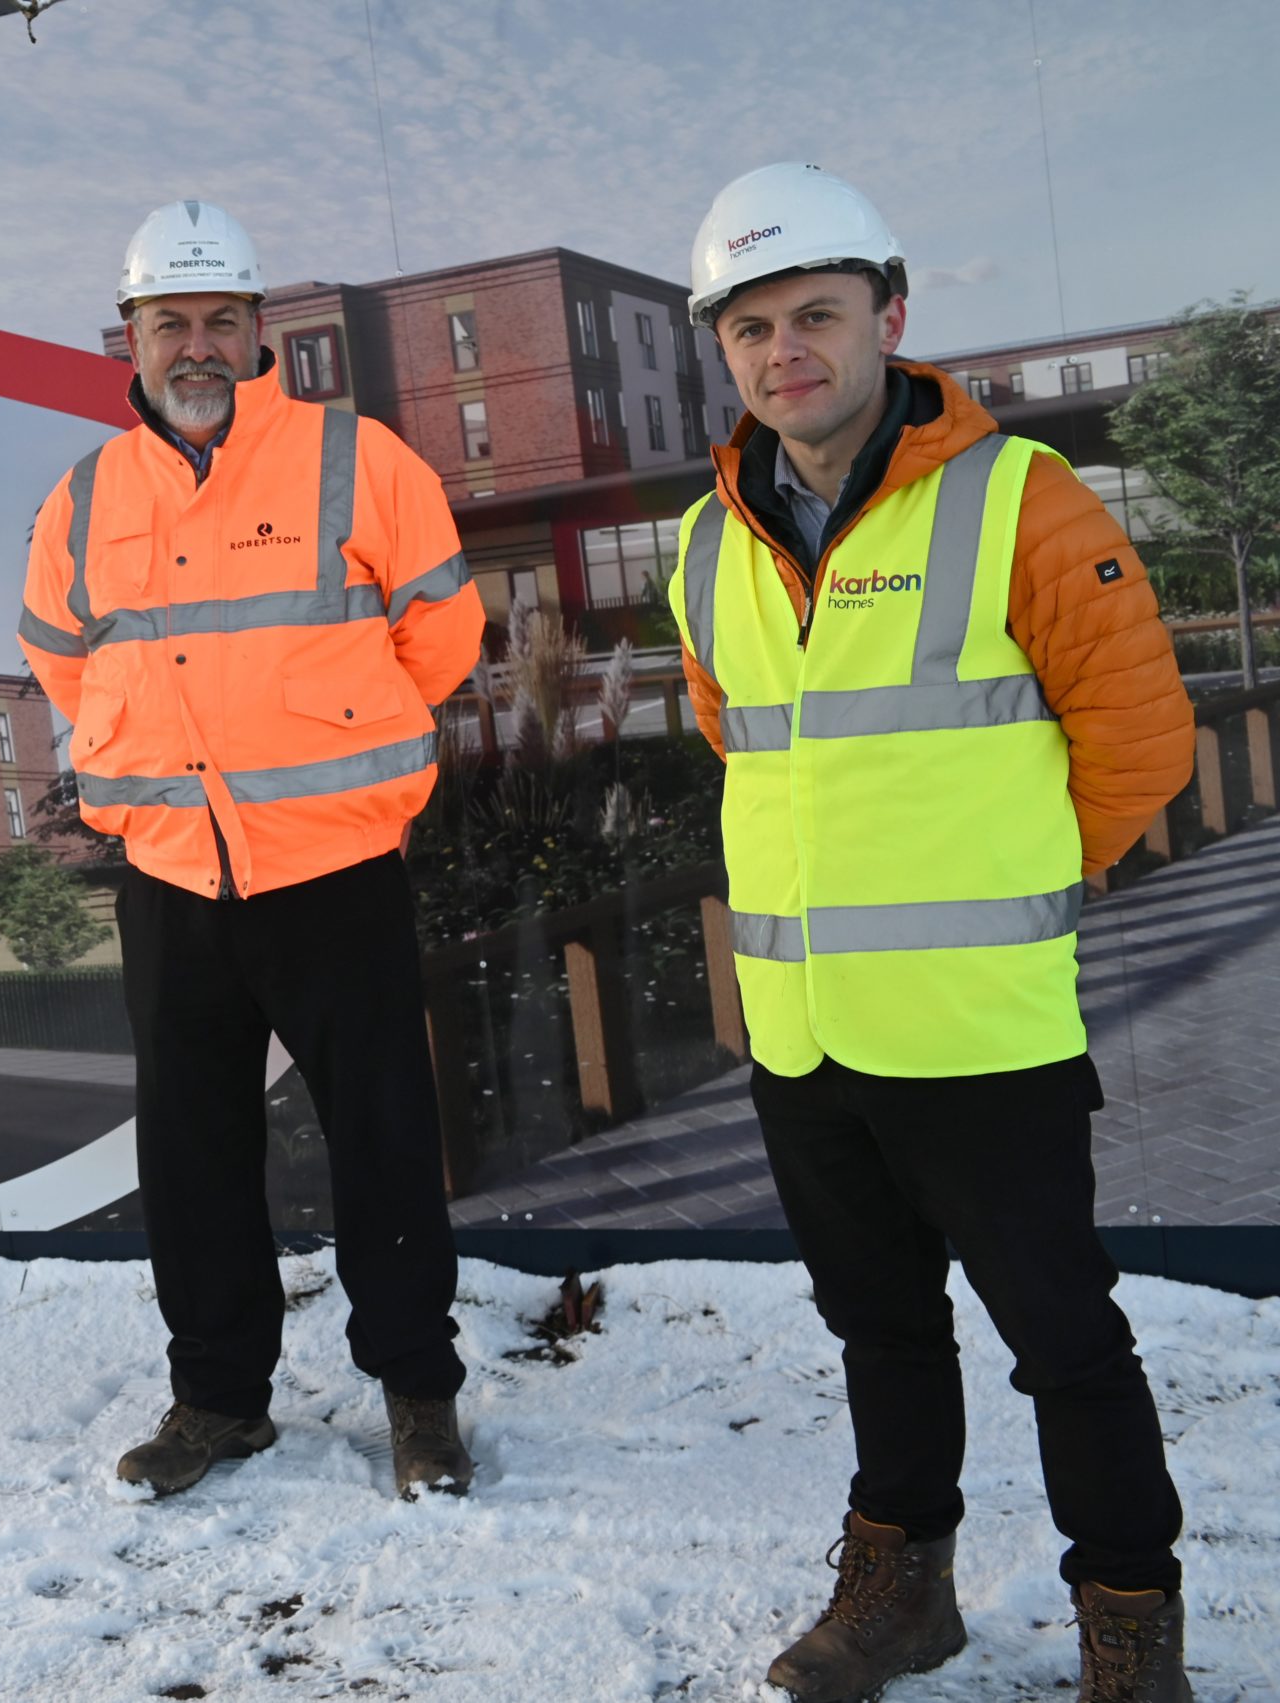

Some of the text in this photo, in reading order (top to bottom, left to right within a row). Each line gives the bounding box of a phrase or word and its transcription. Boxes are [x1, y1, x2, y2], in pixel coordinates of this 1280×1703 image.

[727, 225, 782, 252] karbon
[729, 244, 757, 260] homes
[169, 260, 225, 269] ROBERTSON
[230, 536, 301, 551] ROBERTSON
[829, 569, 922, 595] karbon
[828, 595, 875, 610] homes
